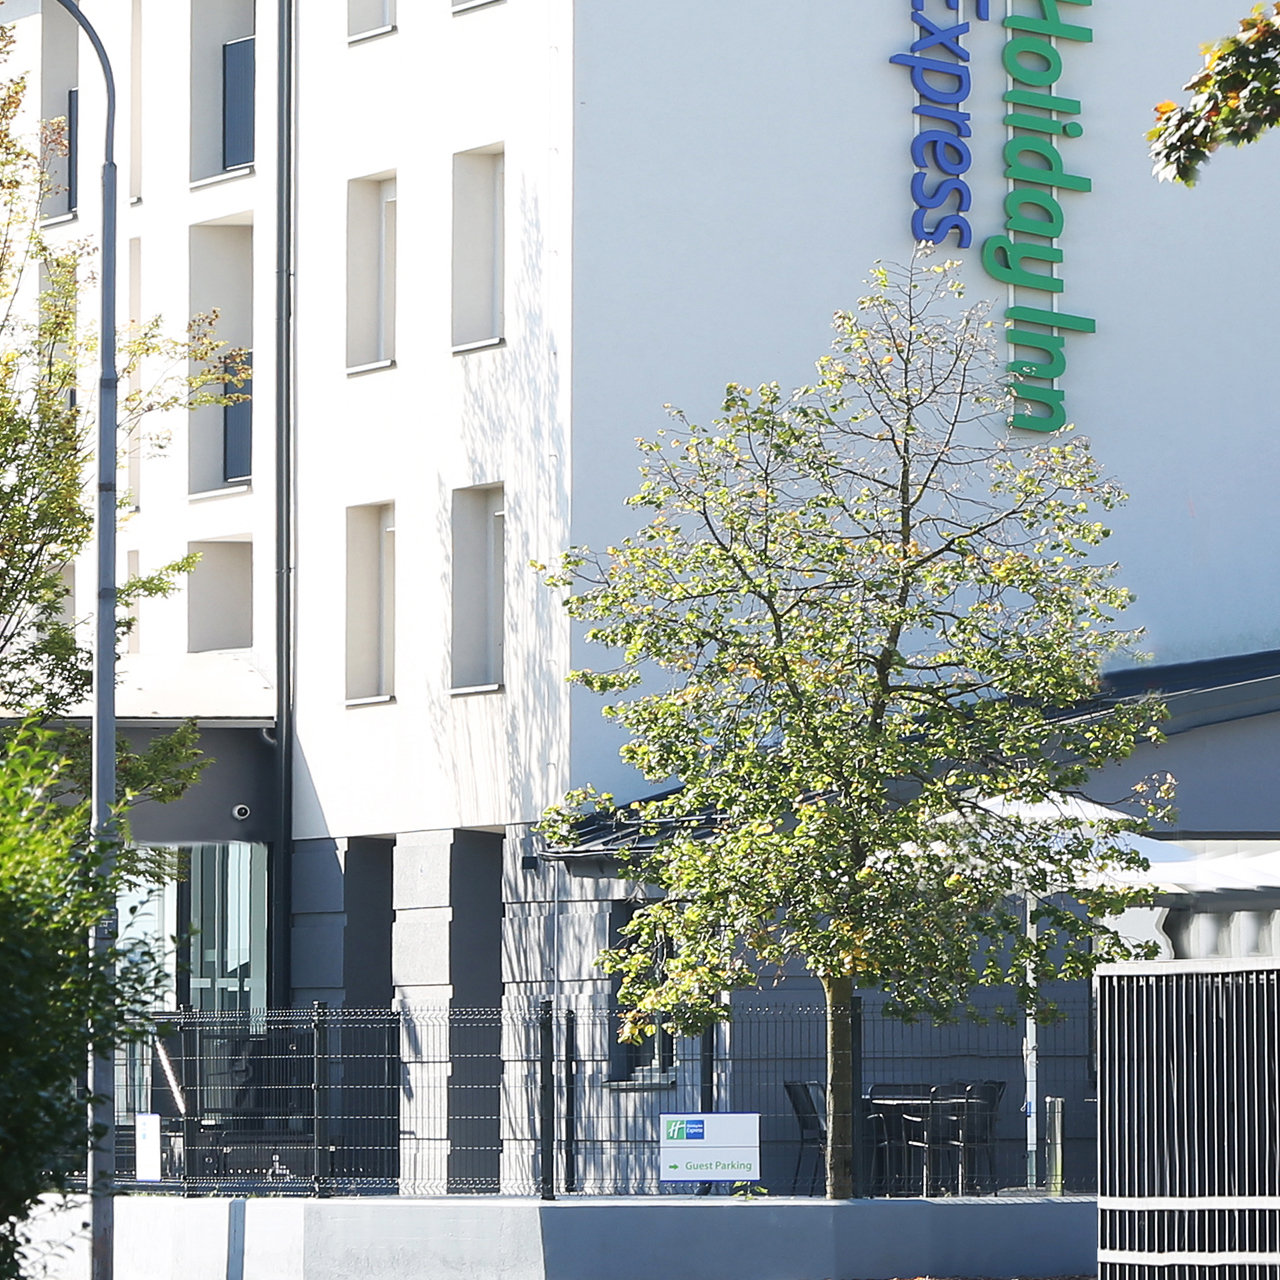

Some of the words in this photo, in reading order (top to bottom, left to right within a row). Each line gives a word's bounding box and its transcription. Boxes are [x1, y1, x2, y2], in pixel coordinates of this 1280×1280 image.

[1005, 306, 1097, 433] Inn
[685, 1161, 713, 1170] Guest
[715, 1161, 752, 1172] Parking
